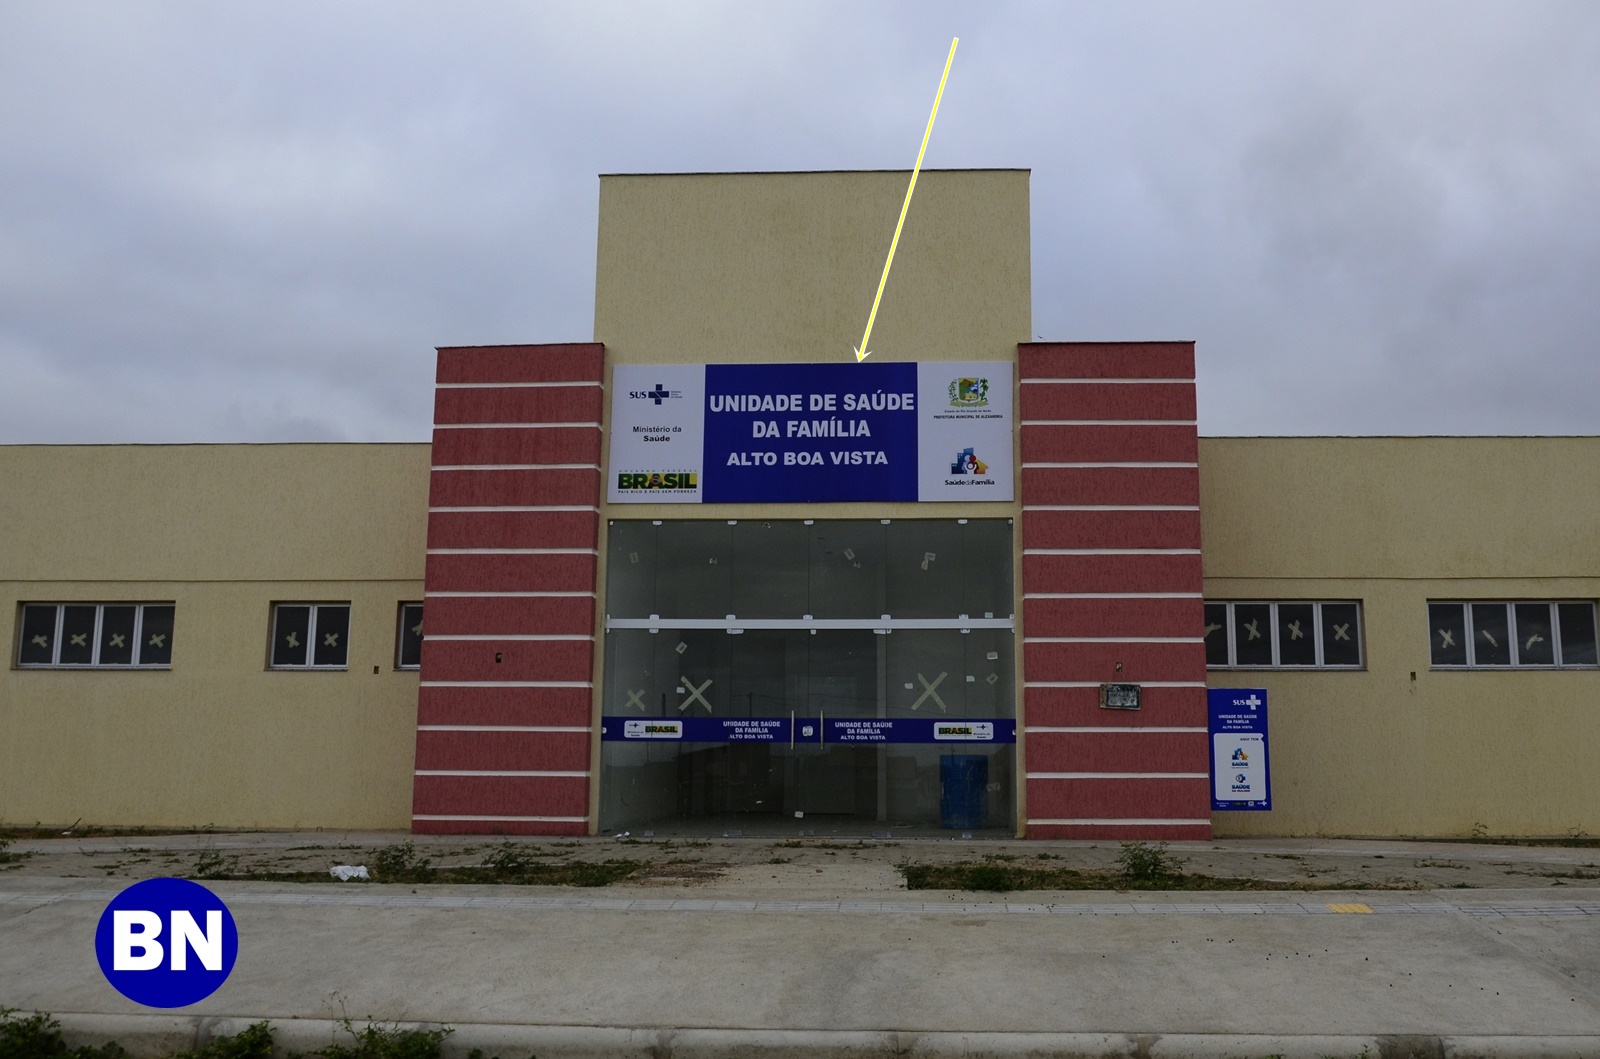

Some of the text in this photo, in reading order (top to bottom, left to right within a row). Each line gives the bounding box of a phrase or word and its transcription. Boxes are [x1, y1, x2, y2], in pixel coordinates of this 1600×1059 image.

[629, 391, 647, 399] SUS
[709, 389, 914, 412] UNIDADE DE SAÚDE
[752, 416, 871, 438] DA FAMÍLIA
[727, 451, 888, 466] ALTO BOA VISTA
[618, 473, 697, 489] BRASIL
